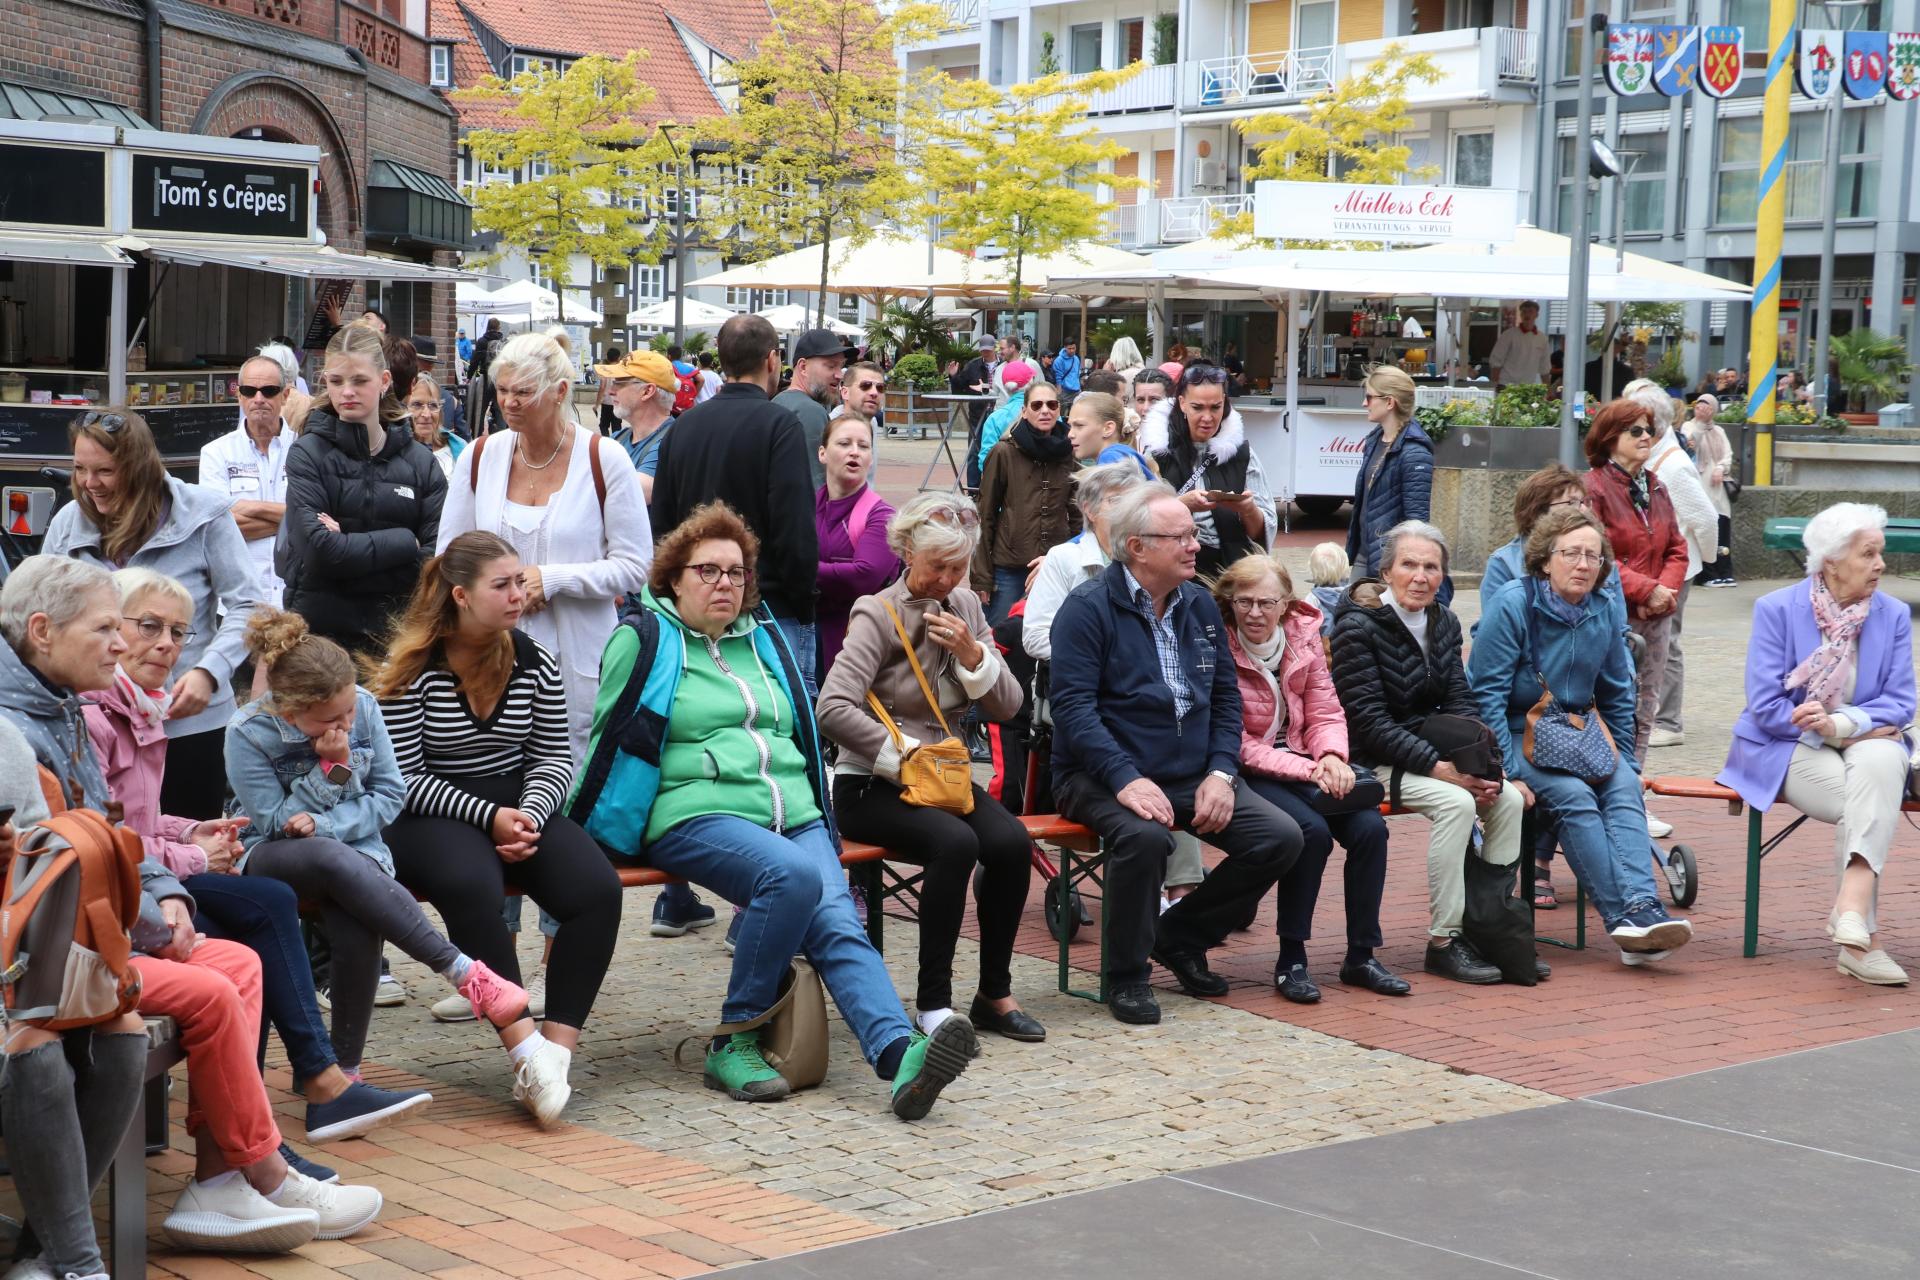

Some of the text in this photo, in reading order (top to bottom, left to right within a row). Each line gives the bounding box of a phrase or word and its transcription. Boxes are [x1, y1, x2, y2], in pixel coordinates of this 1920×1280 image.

[222, 183, 286, 216] Crêpes
[1334, 189, 1453, 217] Müllers Eck
[1333, 221, 1452, 233] VERANSTALTUNGS SERVICE
